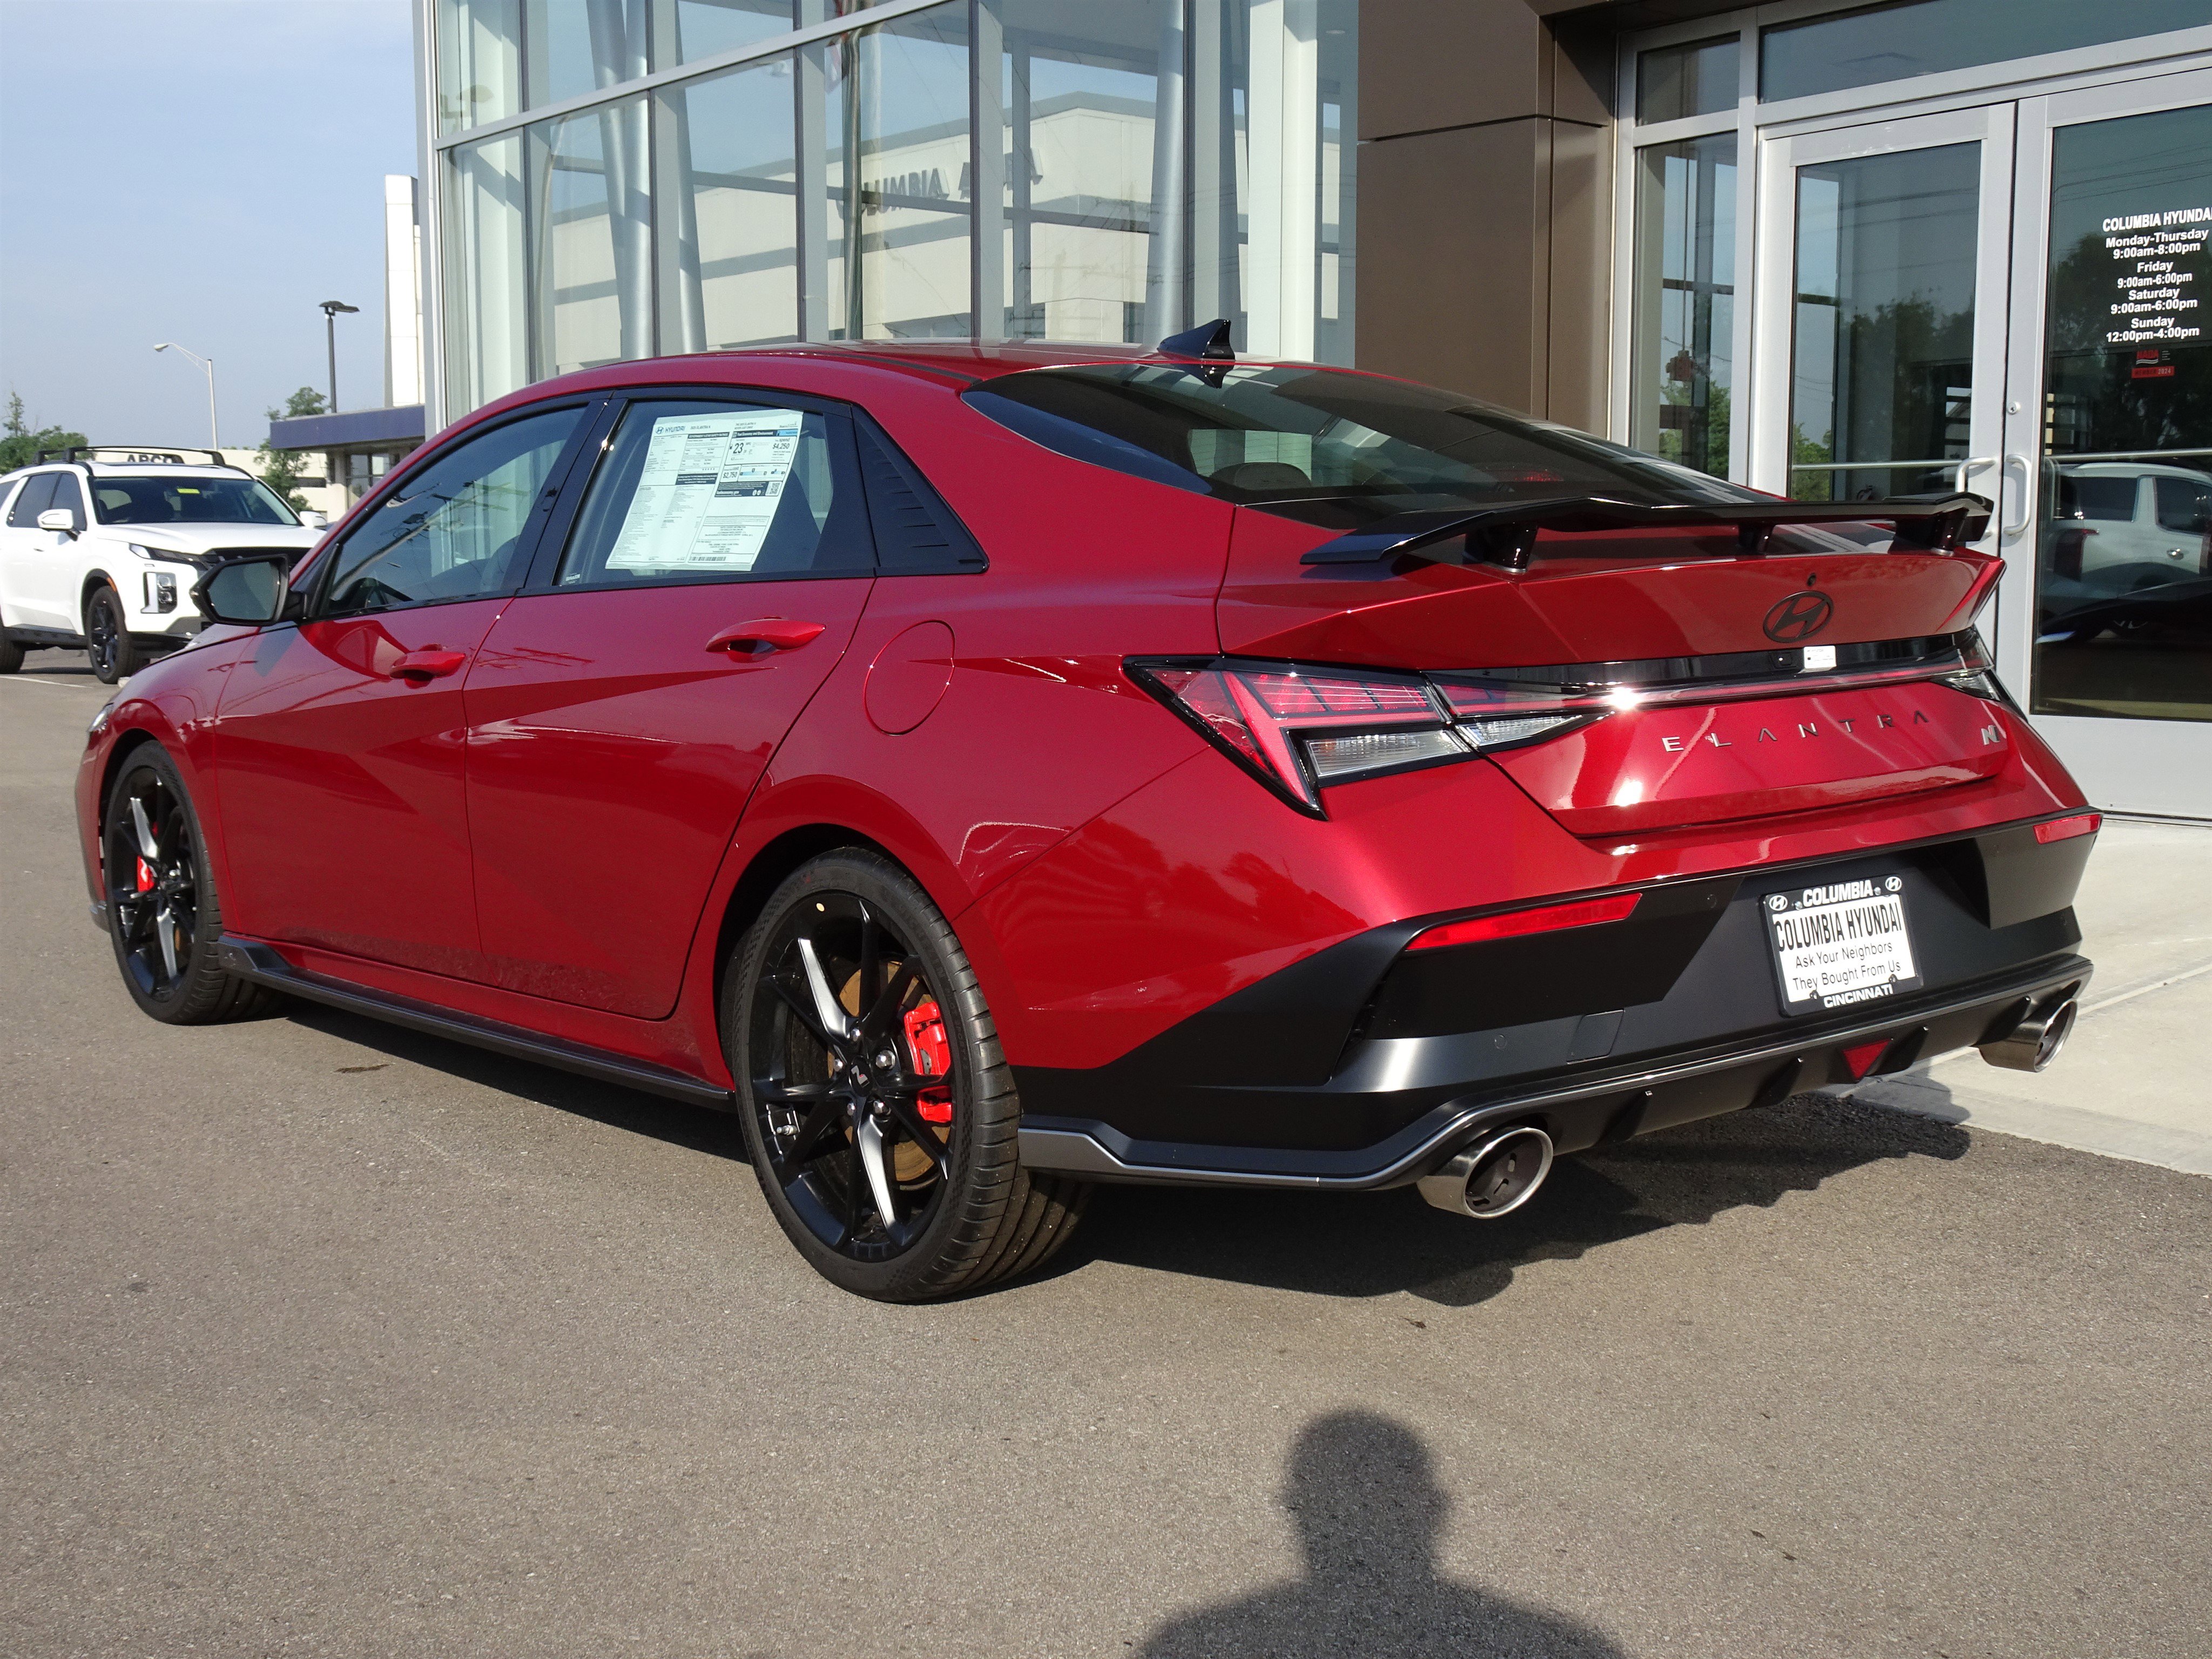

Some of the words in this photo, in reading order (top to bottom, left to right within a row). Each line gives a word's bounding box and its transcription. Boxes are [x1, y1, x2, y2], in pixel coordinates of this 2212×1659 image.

[2103, 213, 2160, 232] COLUMBIA
[2163, 207, 2212, 226] HYUNDA
[2106, 229, 2208, 248] Monday-Thursday
[2113, 242, 2201, 259] 9:00am-8:00pm
[2137, 261, 2174, 273] Friday
[2117, 273, 2193, 288] 9:00am-6:00pm
[2128, 287, 2180, 300] Saturday
[2110, 299, 2198, 315] 9:00am-6:00pm
[2131, 316, 2174, 329] Sunday
[2106, 327, 2200, 343] 12:00pm-4:00pm
[733, 442, 744, 454] 23
[1662, 710, 1928, 752] ELANTRA
[1803, 880, 1873, 907] COLUMBIA
[1774, 911, 1845, 952] COLUMBIA
[1845, 902, 1902, 940] HYUNDAI
[1796, 954, 1815, 969] Ask
[1816, 950, 1839, 965] Your
[1842, 942, 1893, 961] Neighbors
[1793, 976, 1818, 990] They
[1822, 968, 1859, 986] Bought
[1861, 964, 1886, 979] From
[1888, 960, 1901, 973] Us
[1823, 983, 1893, 1008] CINCINNATI
